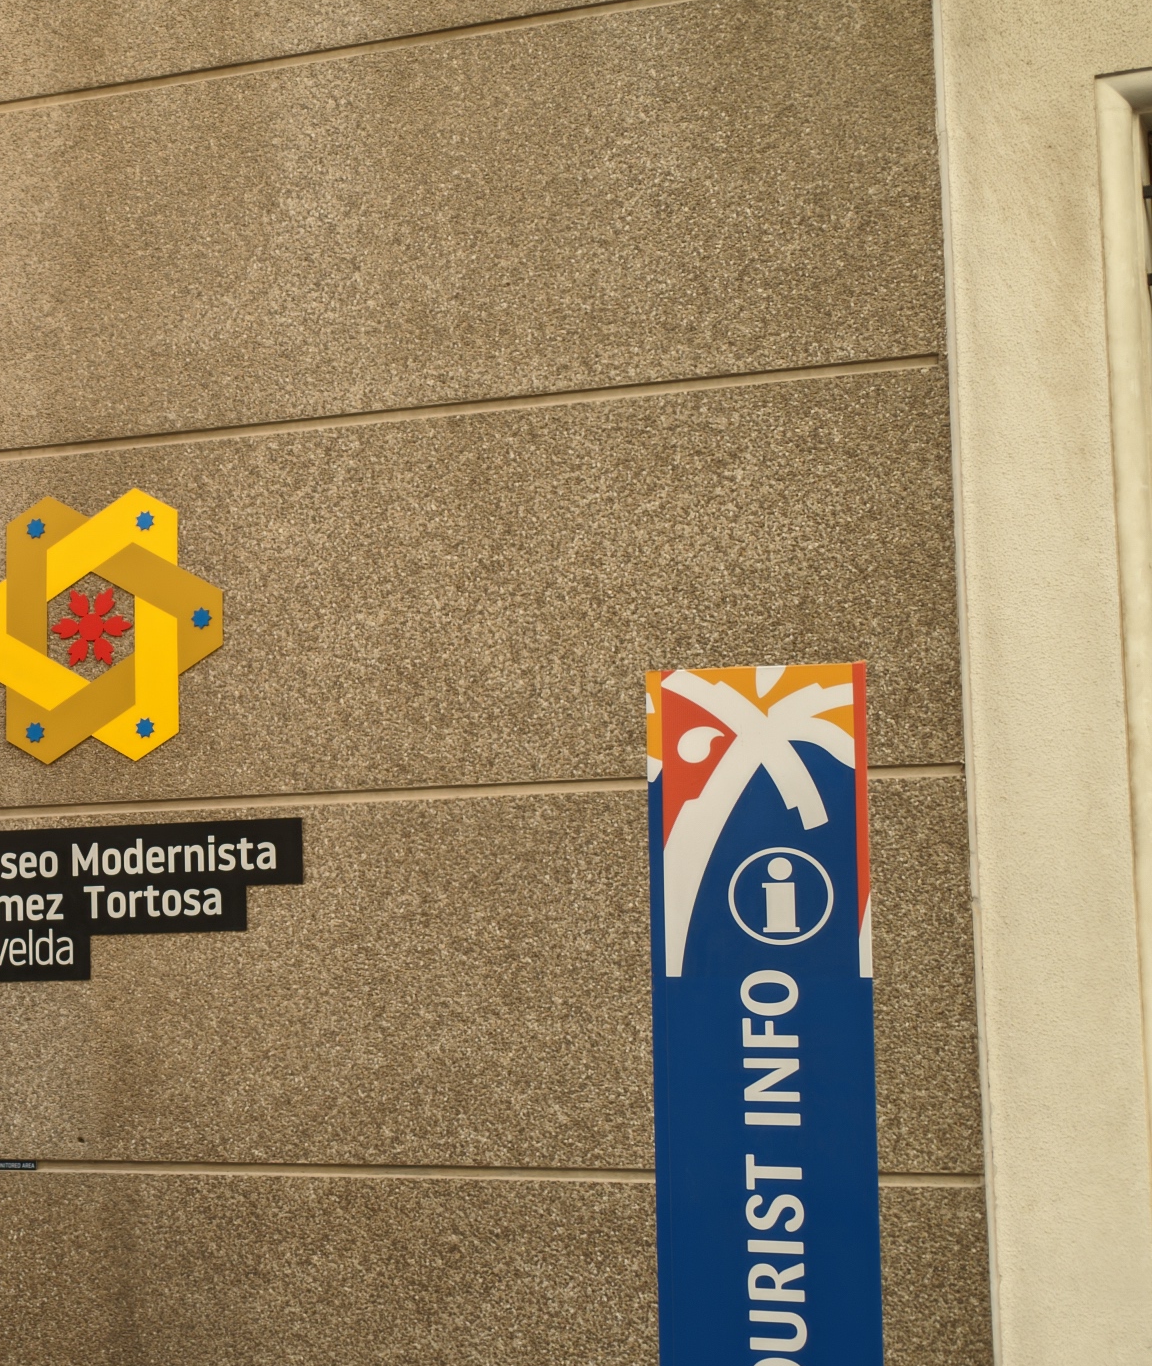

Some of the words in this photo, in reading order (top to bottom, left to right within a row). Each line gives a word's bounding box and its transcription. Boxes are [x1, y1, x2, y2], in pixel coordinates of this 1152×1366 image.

[71, 835, 277, 877] Modernista
[84, 885, 222, 919] Tortosa
[740, 969, 801, 1126] INFO
